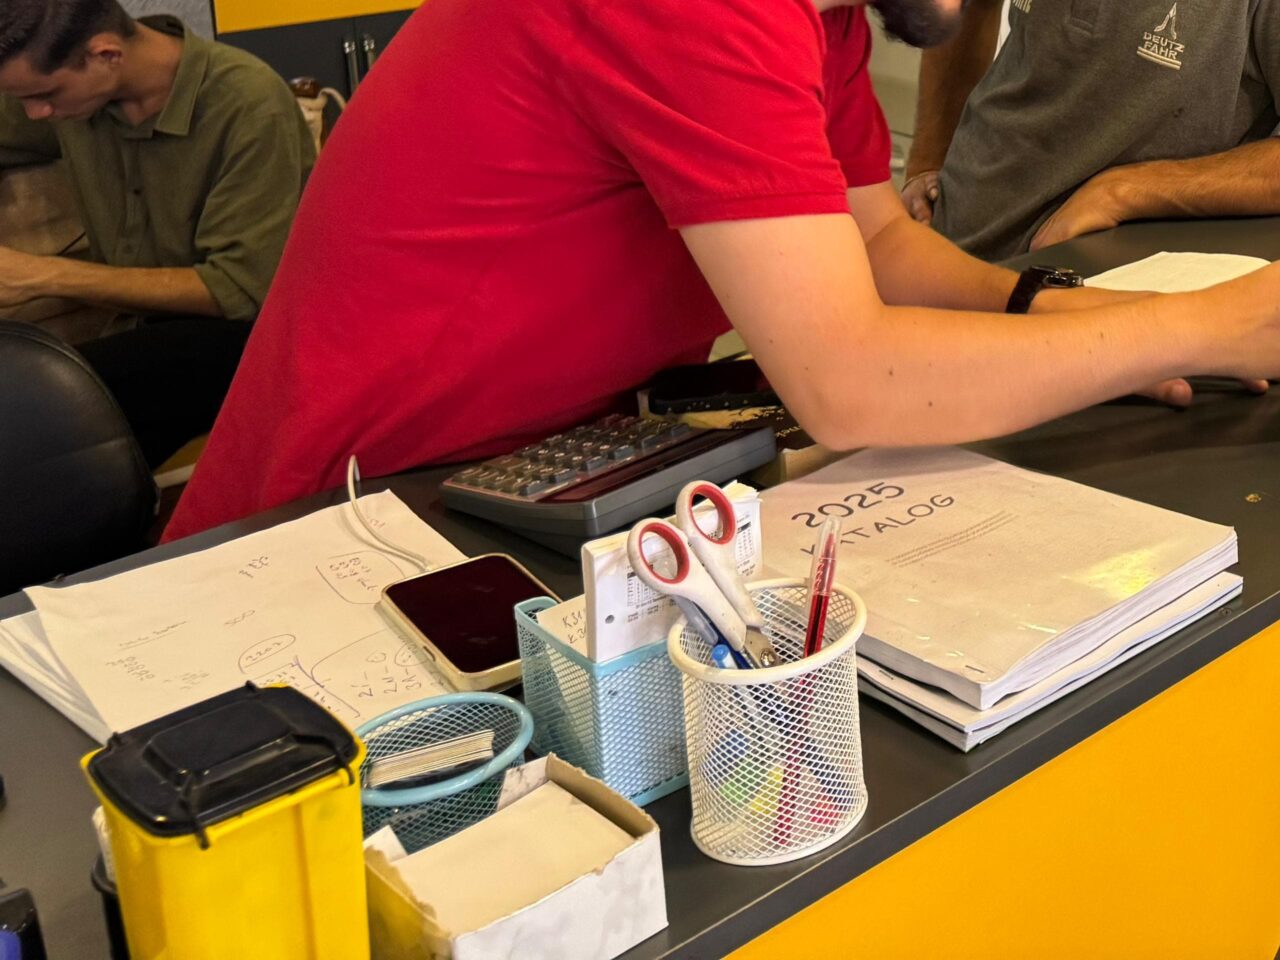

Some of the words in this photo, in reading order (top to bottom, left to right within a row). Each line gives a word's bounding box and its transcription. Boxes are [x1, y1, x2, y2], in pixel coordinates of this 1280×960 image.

[1143, 31, 1185, 53] DEUTZ
[1143, 41, 1179, 60] FAHR
[791, 481, 905, 528] 2025
